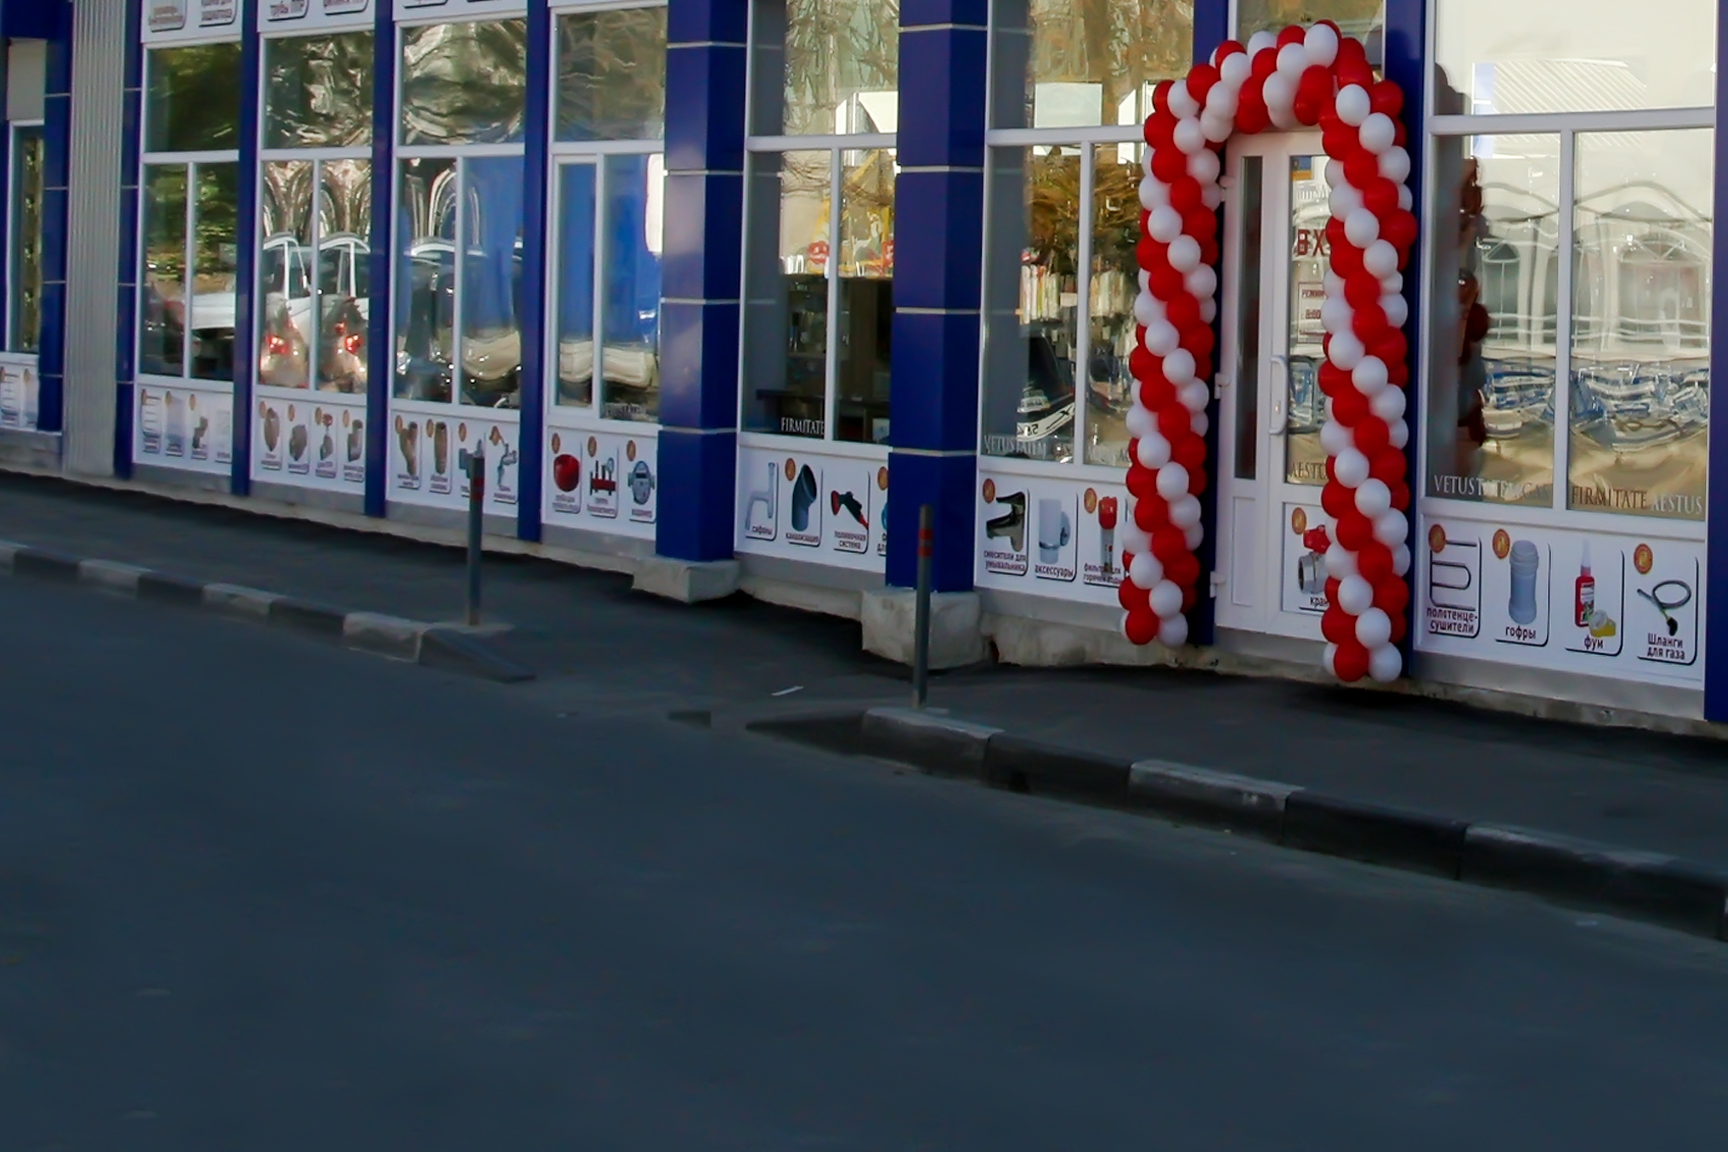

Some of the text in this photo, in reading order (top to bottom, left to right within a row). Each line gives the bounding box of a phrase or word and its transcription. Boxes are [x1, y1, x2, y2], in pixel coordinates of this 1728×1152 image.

[781, 417, 825, 436] FIRMITATE
[1572, 486, 1702, 516] FIRMITATE AESTUS
[1035, 564, 1074, 578] аксессуары
[1430, 619, 1475, 634] сушители
[1505, 624, 1537, 641] гофры
[1647, 632, 1683, 648] Шланги
[1647, 646, 1685, 660] для газа
